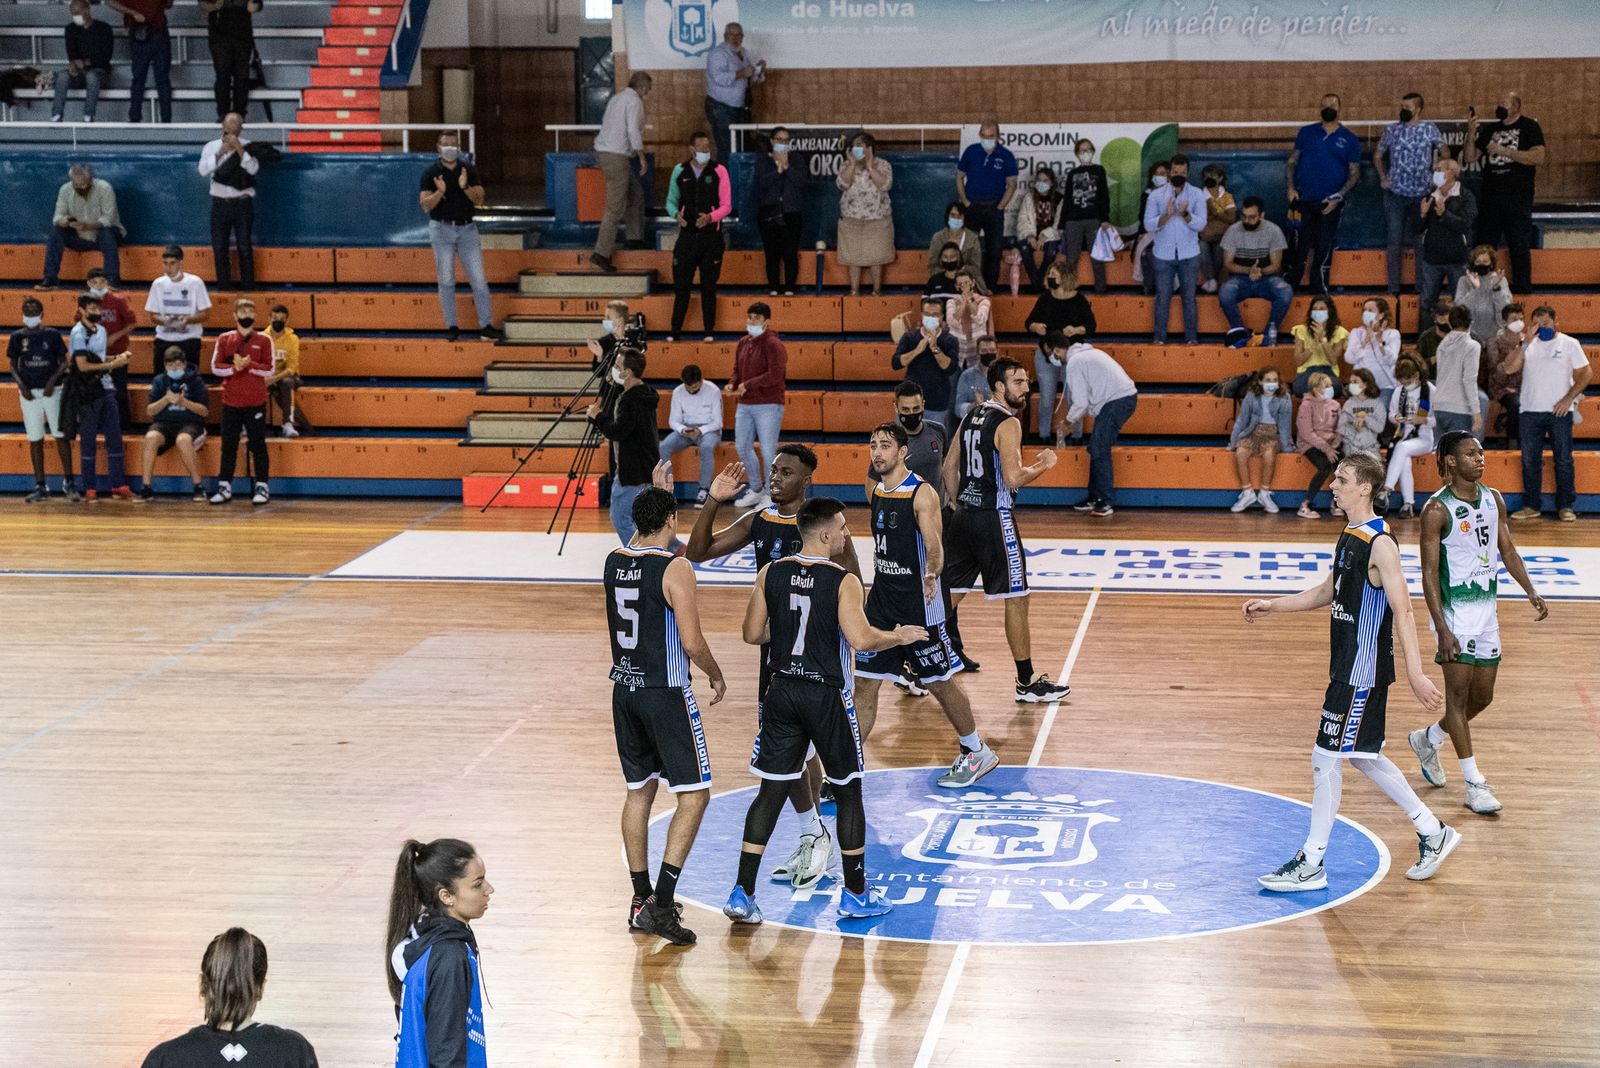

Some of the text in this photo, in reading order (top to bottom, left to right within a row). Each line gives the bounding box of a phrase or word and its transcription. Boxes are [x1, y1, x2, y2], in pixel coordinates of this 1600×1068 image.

[791, 0, 915, 18] de Huelva
[1101, 7, 1133, 37] al
[1143, 6, 1234, 45] miedo
[1241, 6, 1274, 45] de
[999, 132, 1080, 146] SPROMIN
[560, 300, 600, 312] F 10
[546, 347, 577, 359] F 9
[528, 397, 537, 408] F
[512, 447, 520, 459] F
[964, 429, 985, 478] 16
[1474, 525, 1490, 547] 15
[1007, 544, 1023, 588] ENRIQUE
[1117, 559, 1224, 570] de
[614, 586, 640, 650] 5
[789, 593, 812, 656] 7
[1323, 721, 1341, 736] ORO
[1342, 698, 1366, 747] HUELVA
[1124, 878, 1177, 890] de
[790, 884, 1173, 915] HUELVA
